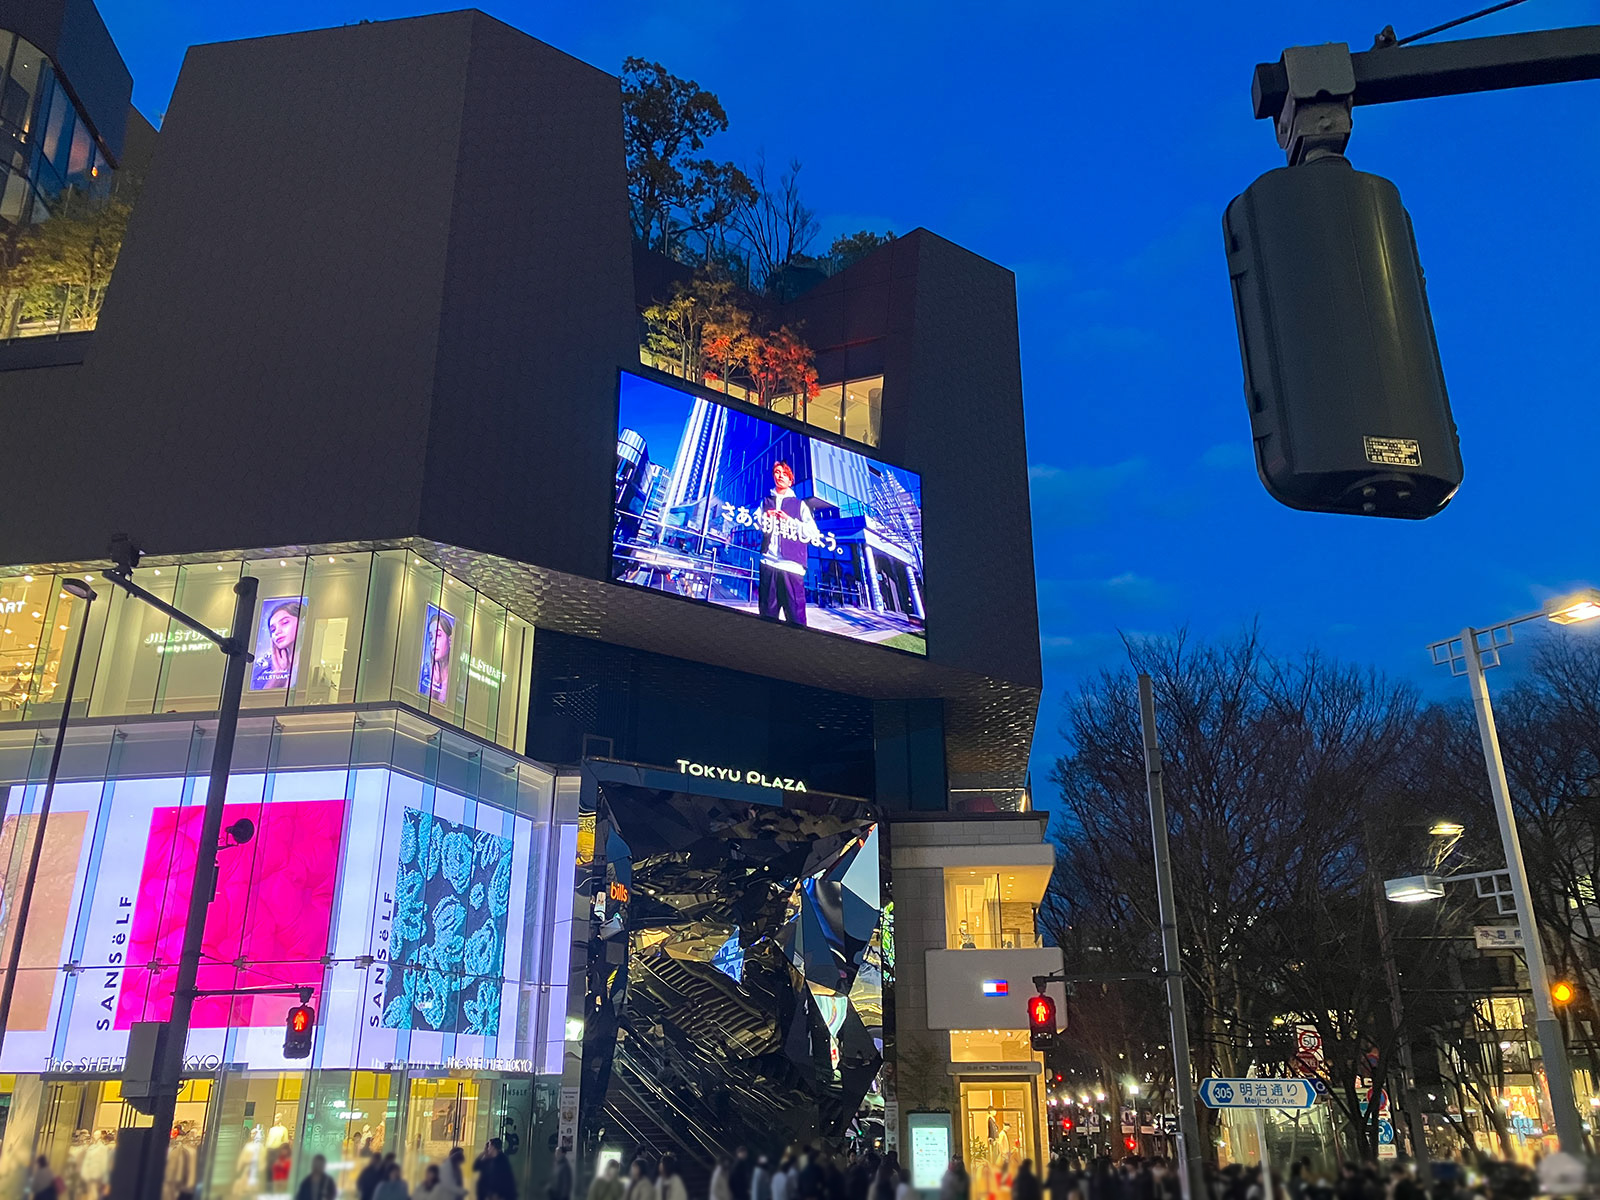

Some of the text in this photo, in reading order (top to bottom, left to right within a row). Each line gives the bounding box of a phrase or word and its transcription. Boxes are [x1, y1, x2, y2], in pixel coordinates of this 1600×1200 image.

[144, 628, 228, 644] JILLSTUT
[676, 758, 808, 793] TOKYU PLAZA
[610, 881, 628, 903] bills
[44, 1054, 221, 1073] The SHELT KYO
[1214, 1087, 1234, 1099] 305
[1239, 1082, 1298, 1097] 明治通り
[1244, 1096, 1279, 1106] Meiji-dori
